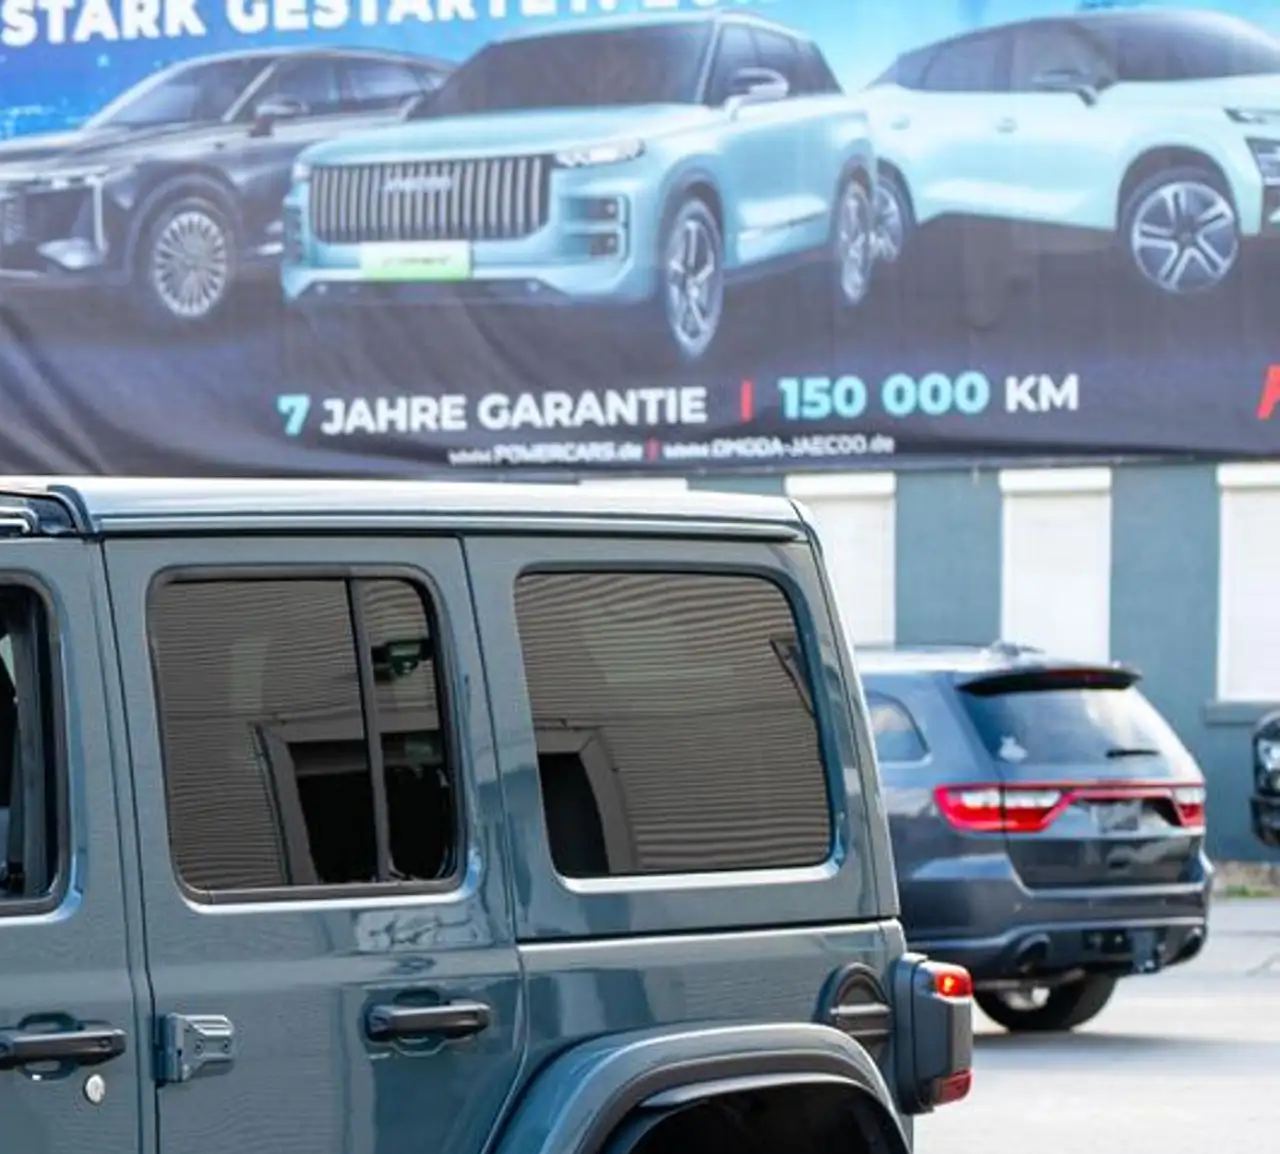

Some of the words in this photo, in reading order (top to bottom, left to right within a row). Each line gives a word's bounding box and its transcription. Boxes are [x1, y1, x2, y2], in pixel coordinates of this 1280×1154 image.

[0, 0, 207, 47] STARK
[276, 394, 311, 436] 7
[320, 394, 467, 436] JAHRE
[476, 386, 708, 432] GARANTIE
[778, 375, 867, 419] 150
[881, 370, 991, 415] 000
[1004, 372, 1080, 413] KM
